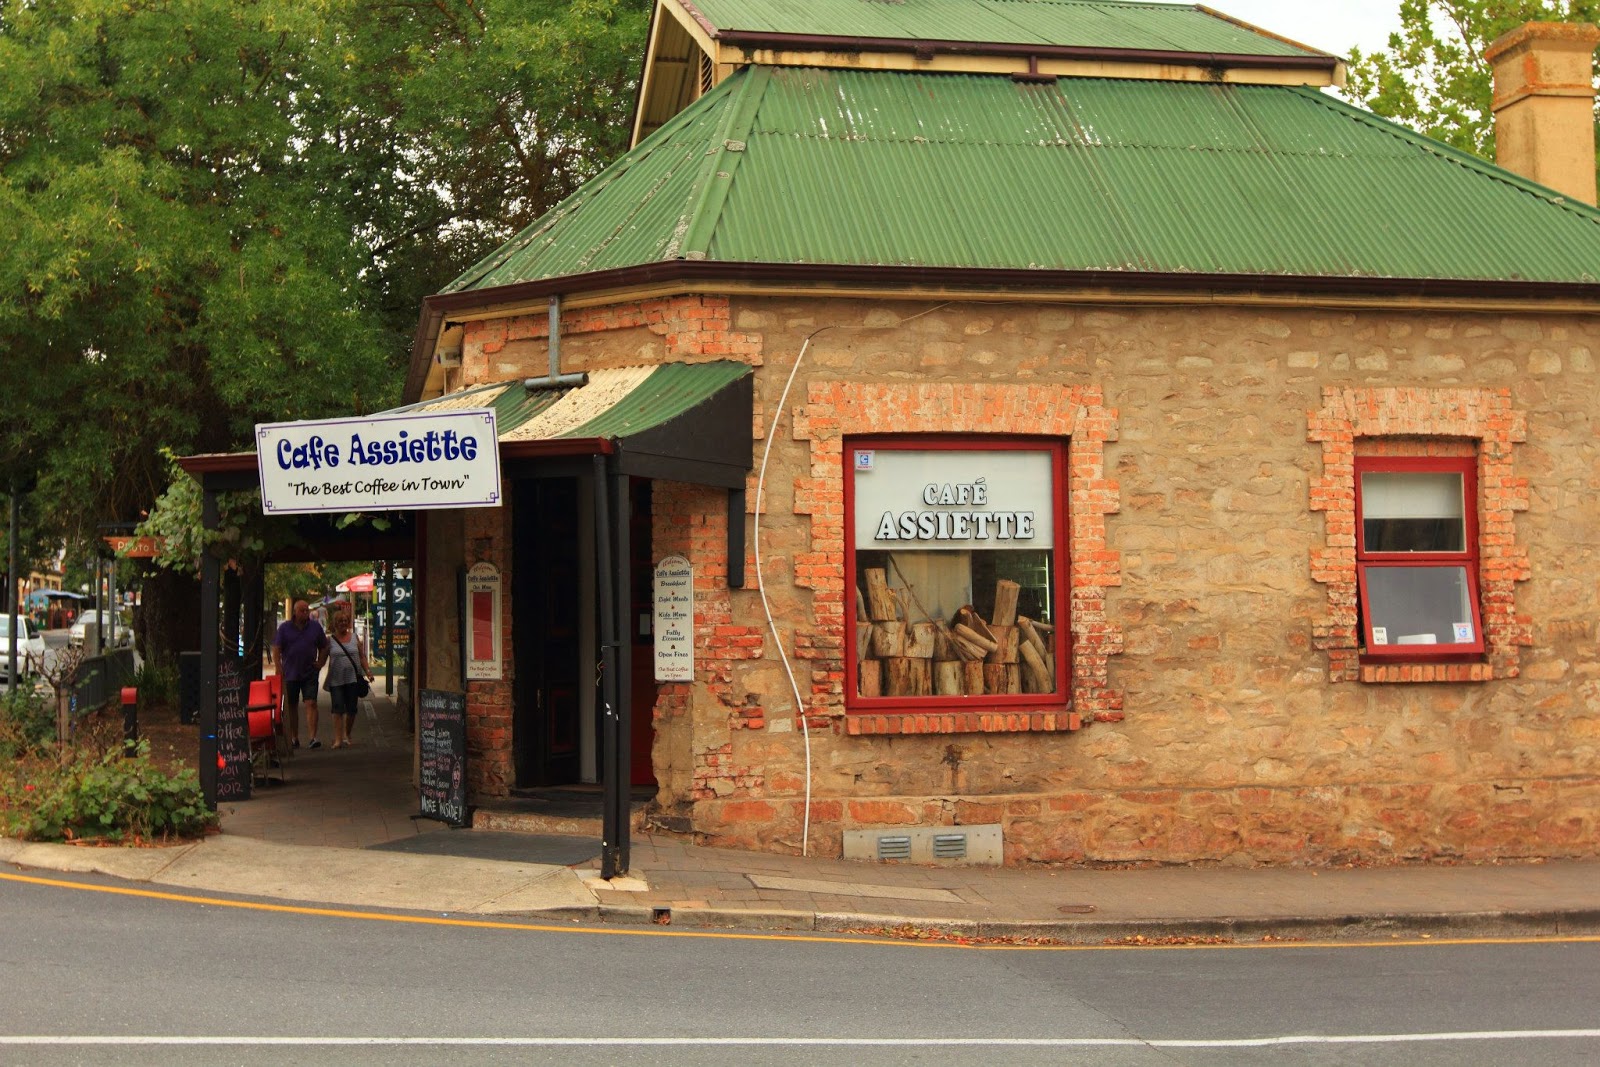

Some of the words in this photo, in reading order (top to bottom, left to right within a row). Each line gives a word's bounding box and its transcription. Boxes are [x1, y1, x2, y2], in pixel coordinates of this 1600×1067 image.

[277, 435, 340, 471] Cafe
[348, 429, 477, 466] Assiette
[288, 482, 321, 497] "The
[323, 480, 352, 495] Best
[355, 478, 399, 495] Coffee
[401, 478, 420, 491] in
[422, 474, 470, 491] Town"
[922, 476, 988, 506] CAFÉ
[875, 511, 1035, 541] ASSIETTE
[658, 651, 673, 659] Open
[217, 782, 244, 796] 2012
